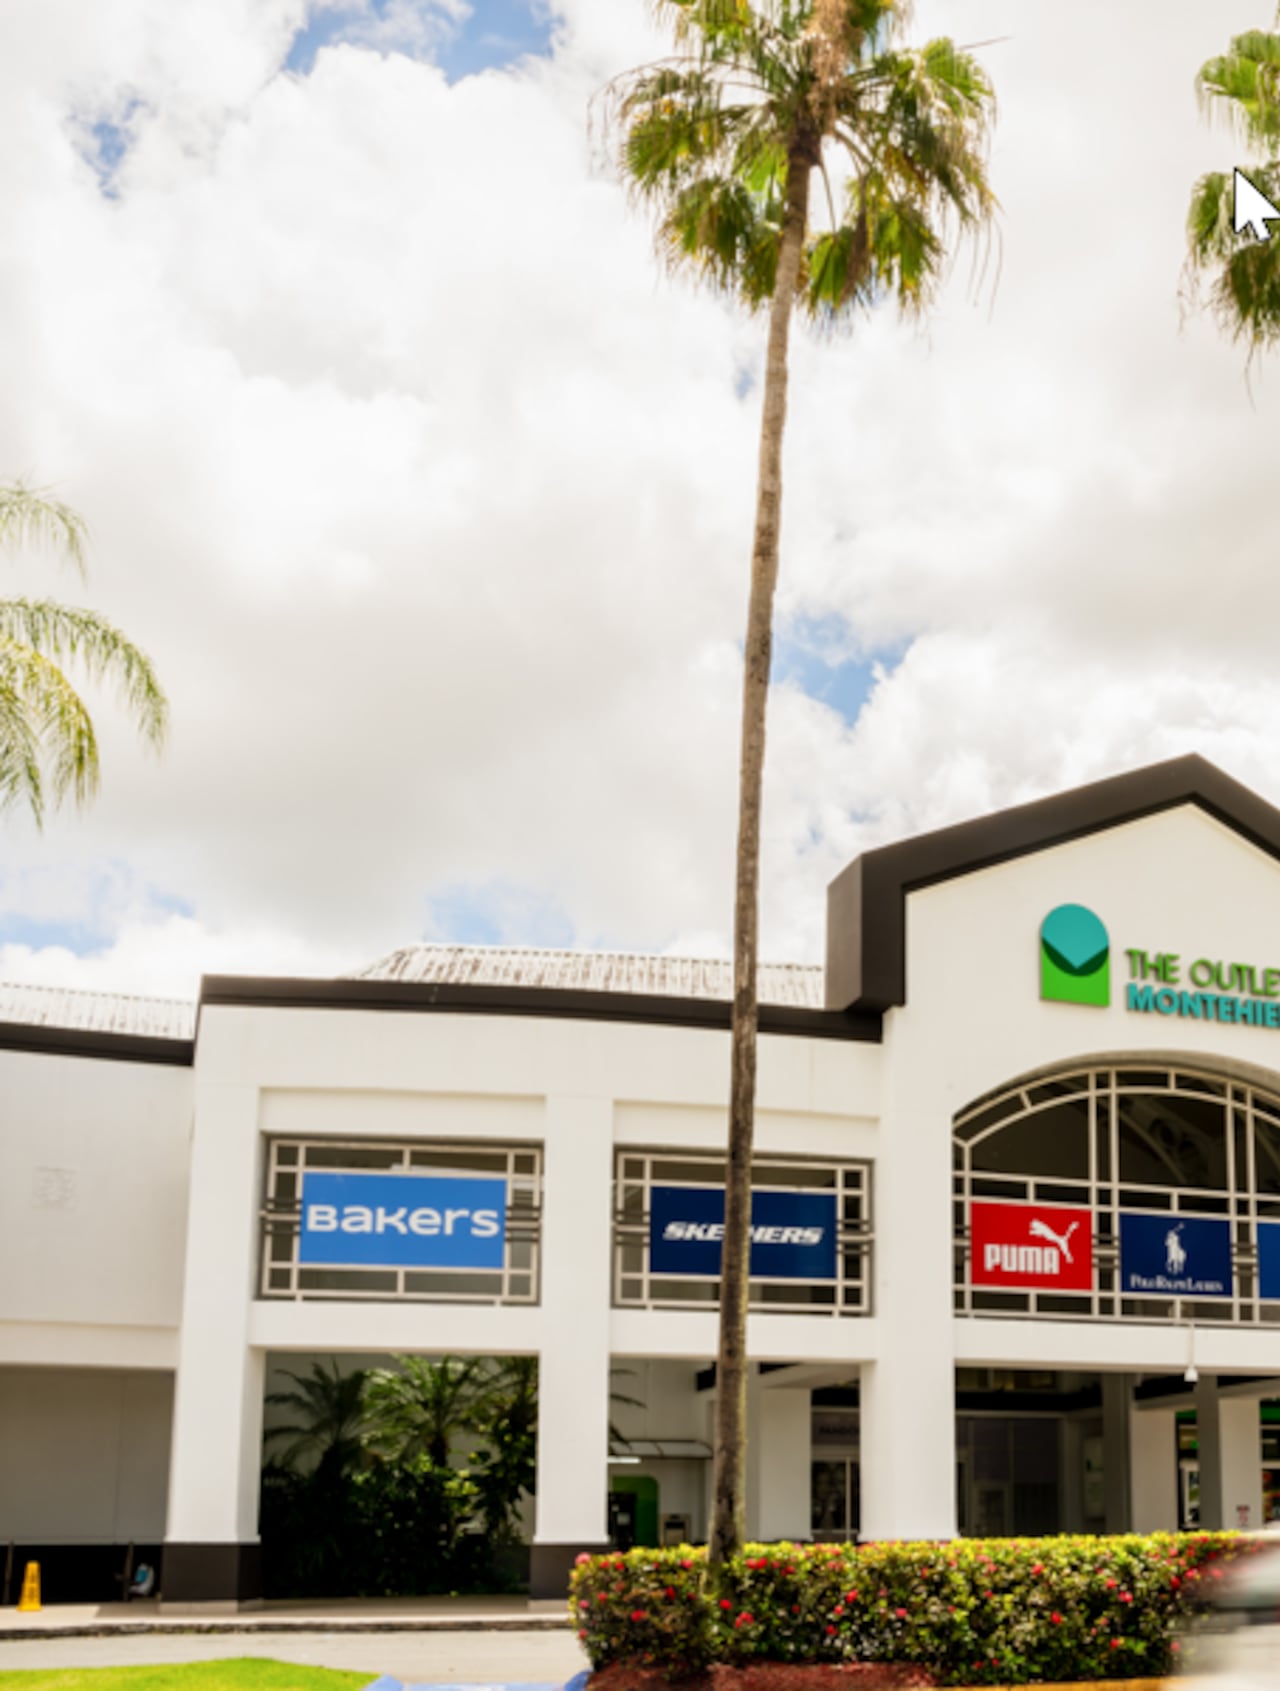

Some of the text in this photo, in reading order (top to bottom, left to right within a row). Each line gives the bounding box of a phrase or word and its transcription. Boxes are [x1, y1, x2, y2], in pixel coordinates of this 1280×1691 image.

[1125, 949, 1180, 984] THE
[662, 1221, 825, 1246] SKEHERS
[984, 1243, 1060, 1275] PUMA
